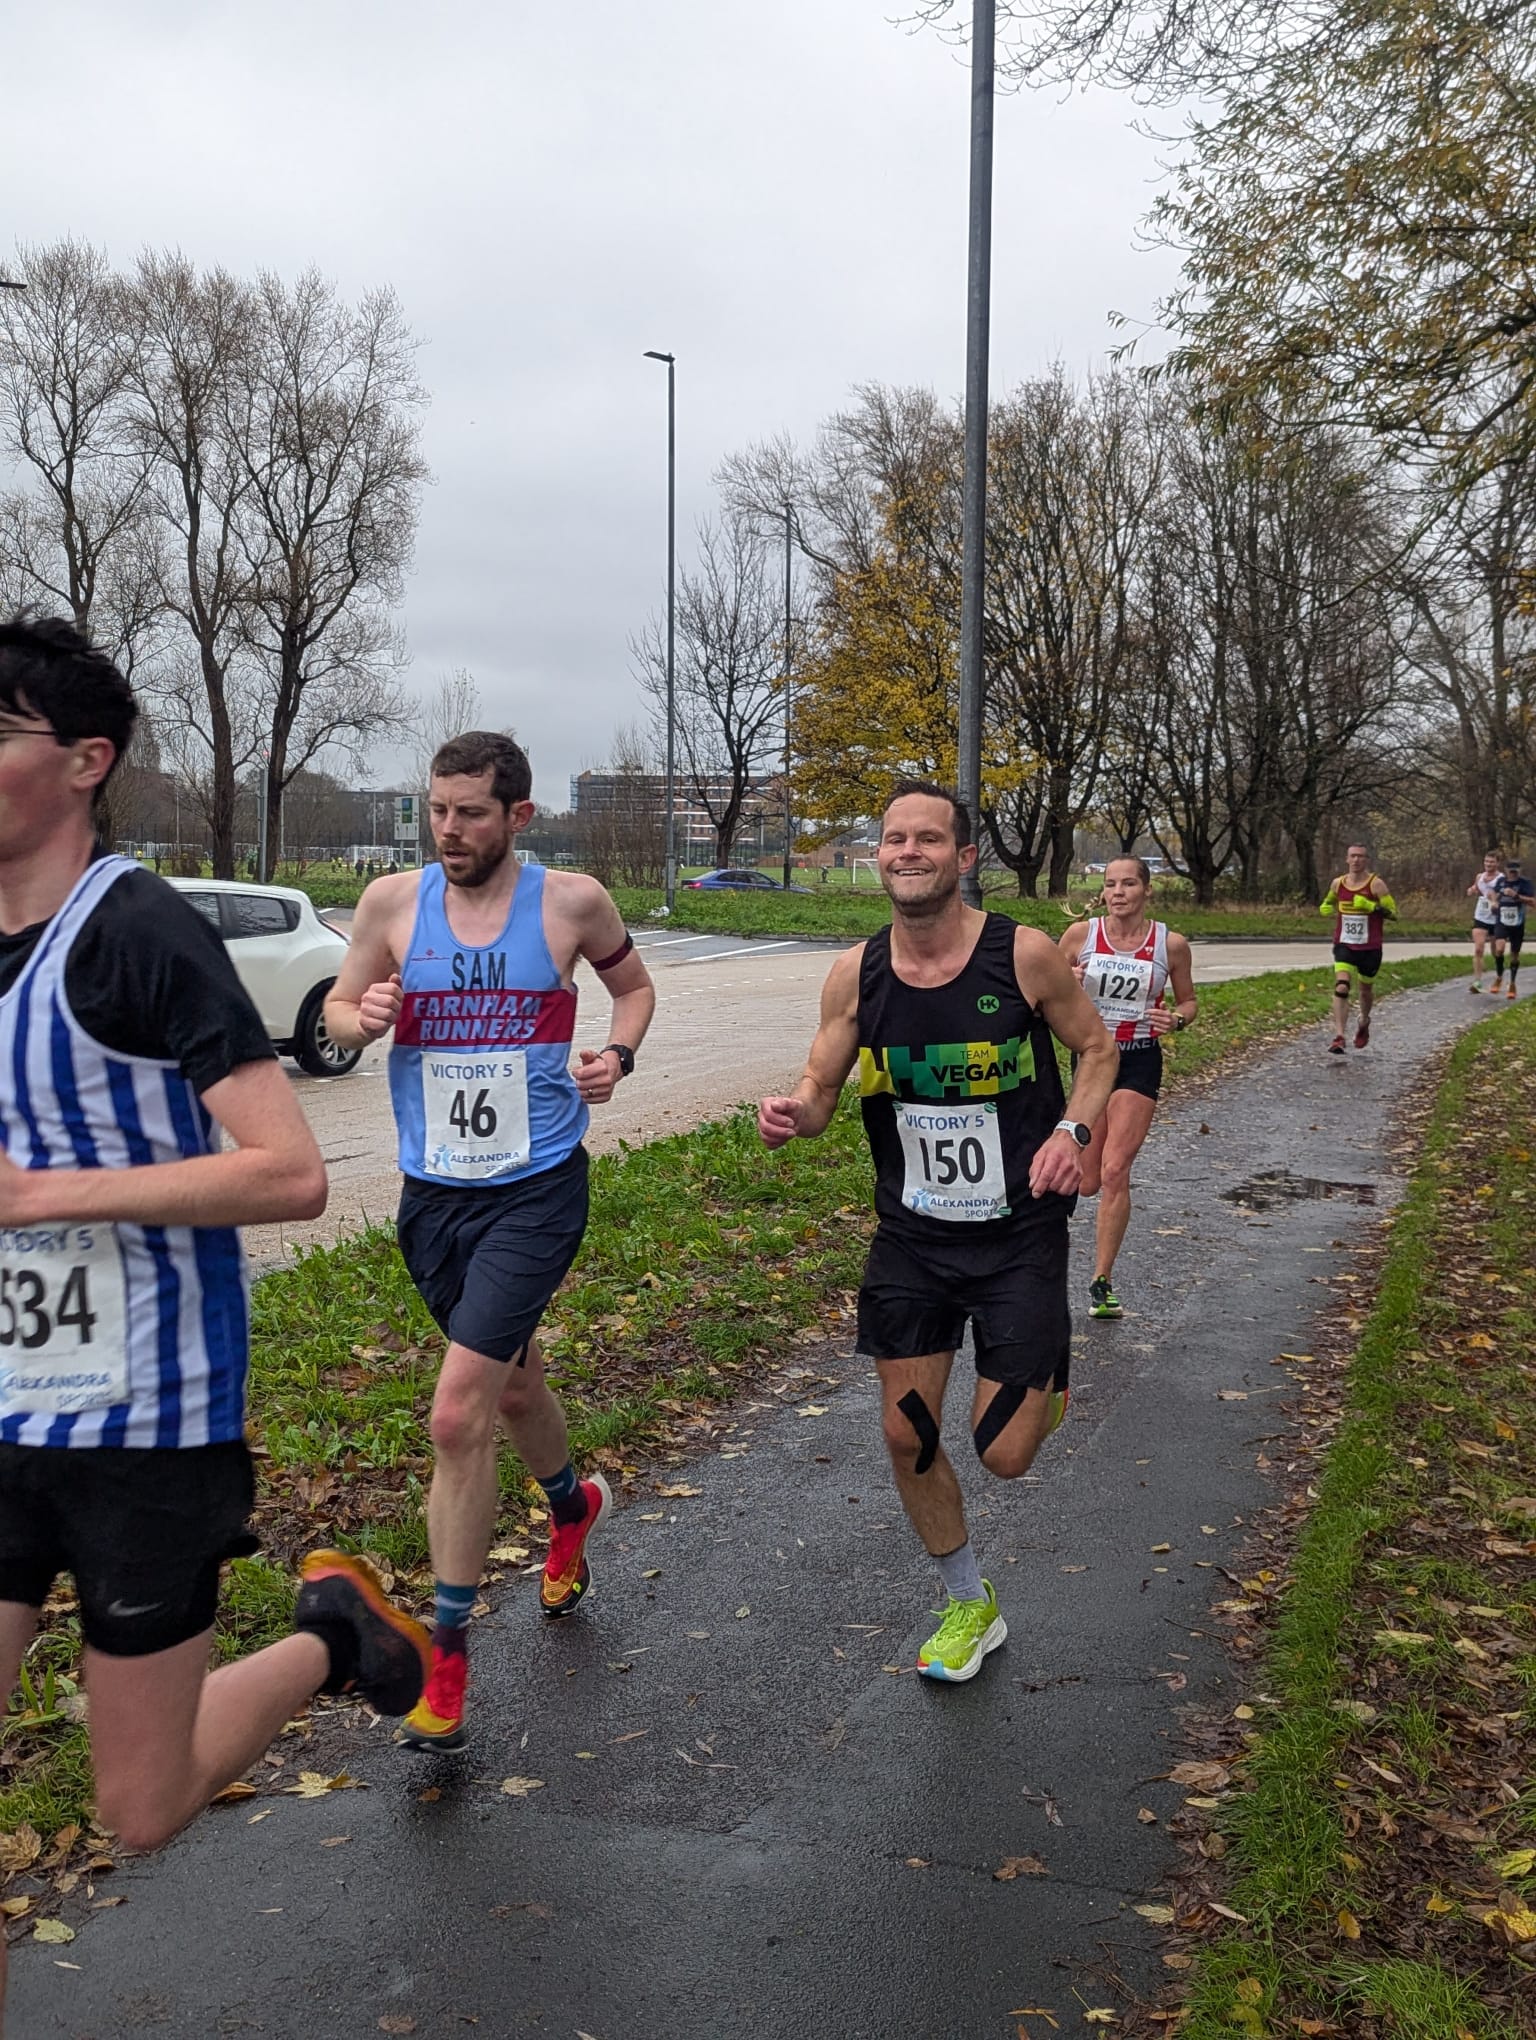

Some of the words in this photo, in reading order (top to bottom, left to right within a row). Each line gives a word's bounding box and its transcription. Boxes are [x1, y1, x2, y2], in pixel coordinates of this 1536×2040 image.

[1344, 922, 1364, 935] 382
[451, 951, 507, 992] SAM
[1096, 959, 1138, 973] VICTORY
[1138, 966, 1145, 974] 5
[1098, 973, 1140, 1001] 122
[413, 996, 543, 1018] FARNHAM
[980, 998, 998, 1010] HK
[420, 1018, 537, 1041] RUNNERS
[960, 1049, 990, 1060] TEAM
[430, 1063, 498, 1080] VICTORY
[503, 1063, 513, 1077] 5
[930, 1057, 1017, 1083] VEGAN
[449, 1088, 498, 1138] 46
[905, 1113, 969, 1131] VICTORY
[975, 1115, 985, 1128] 5
[450, 1151, 520, 1164] ALEXANDRA
[919, 1136, 986, 1186] 150
[929, 1198, 998, 1208] ALEXANDRA
[77, 1228, 94, 1250] 5
